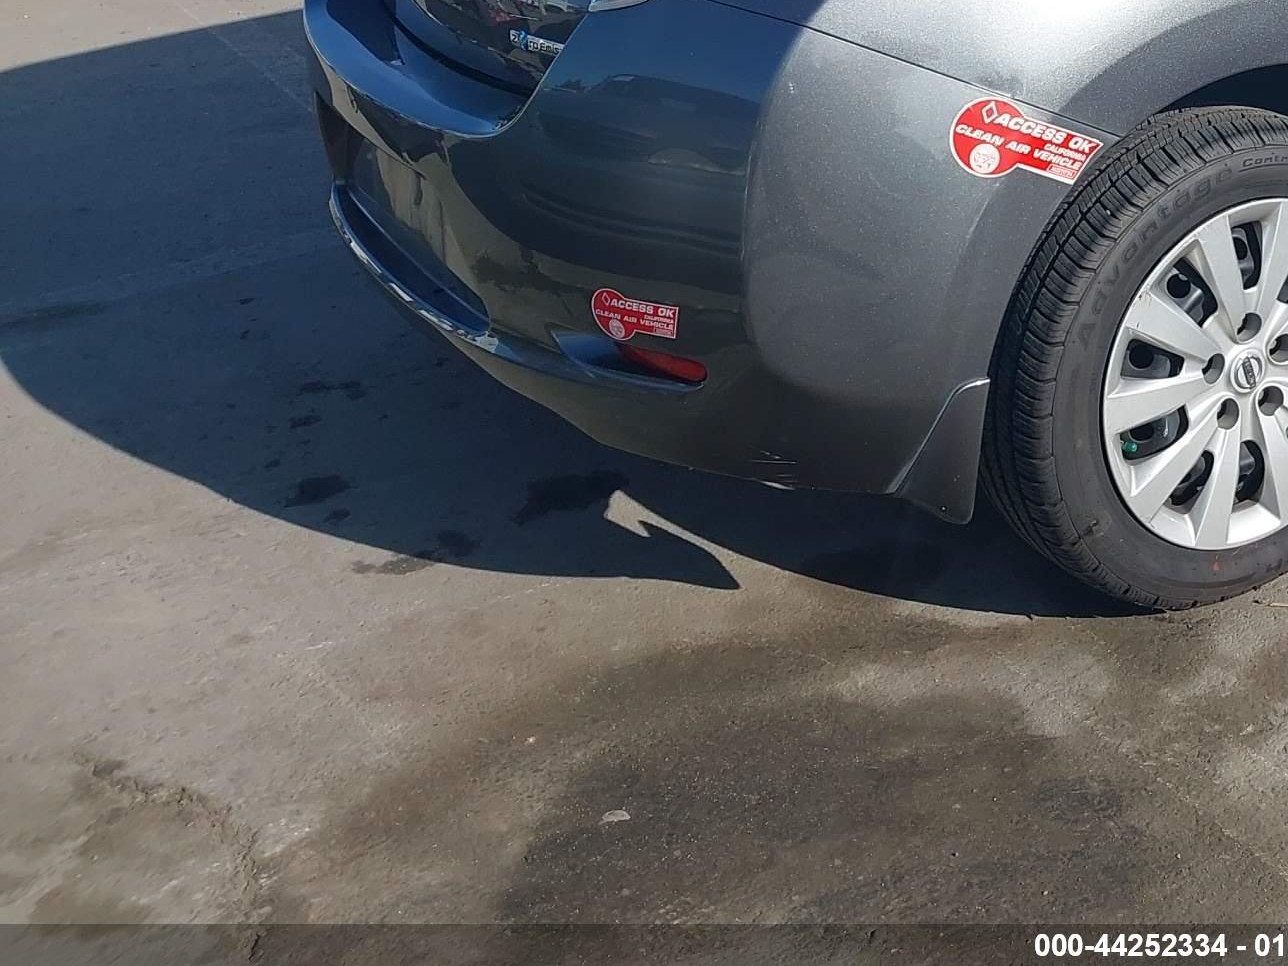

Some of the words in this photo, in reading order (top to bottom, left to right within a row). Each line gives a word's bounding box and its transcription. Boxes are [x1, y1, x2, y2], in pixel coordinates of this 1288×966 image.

[994, 113, 1067, 144] ACCESS
[1068, 137, 1098, 154] OK
[955, 124, 1004, 146] CLEAN
[1005, 140, 1031, 155] AIR
[1033, 148, 1083, 171] VEHICLE
[1044, 143, 1087, 161] CALIFORNIA
[610, 298, 654, 314] ACCESS
[658, 307, 675, 318] OK
[595, 309, 621, 320] CLEAN
[623, 315, 637, 323] AIR
[640, 318, 674, 330] VEHICLE
